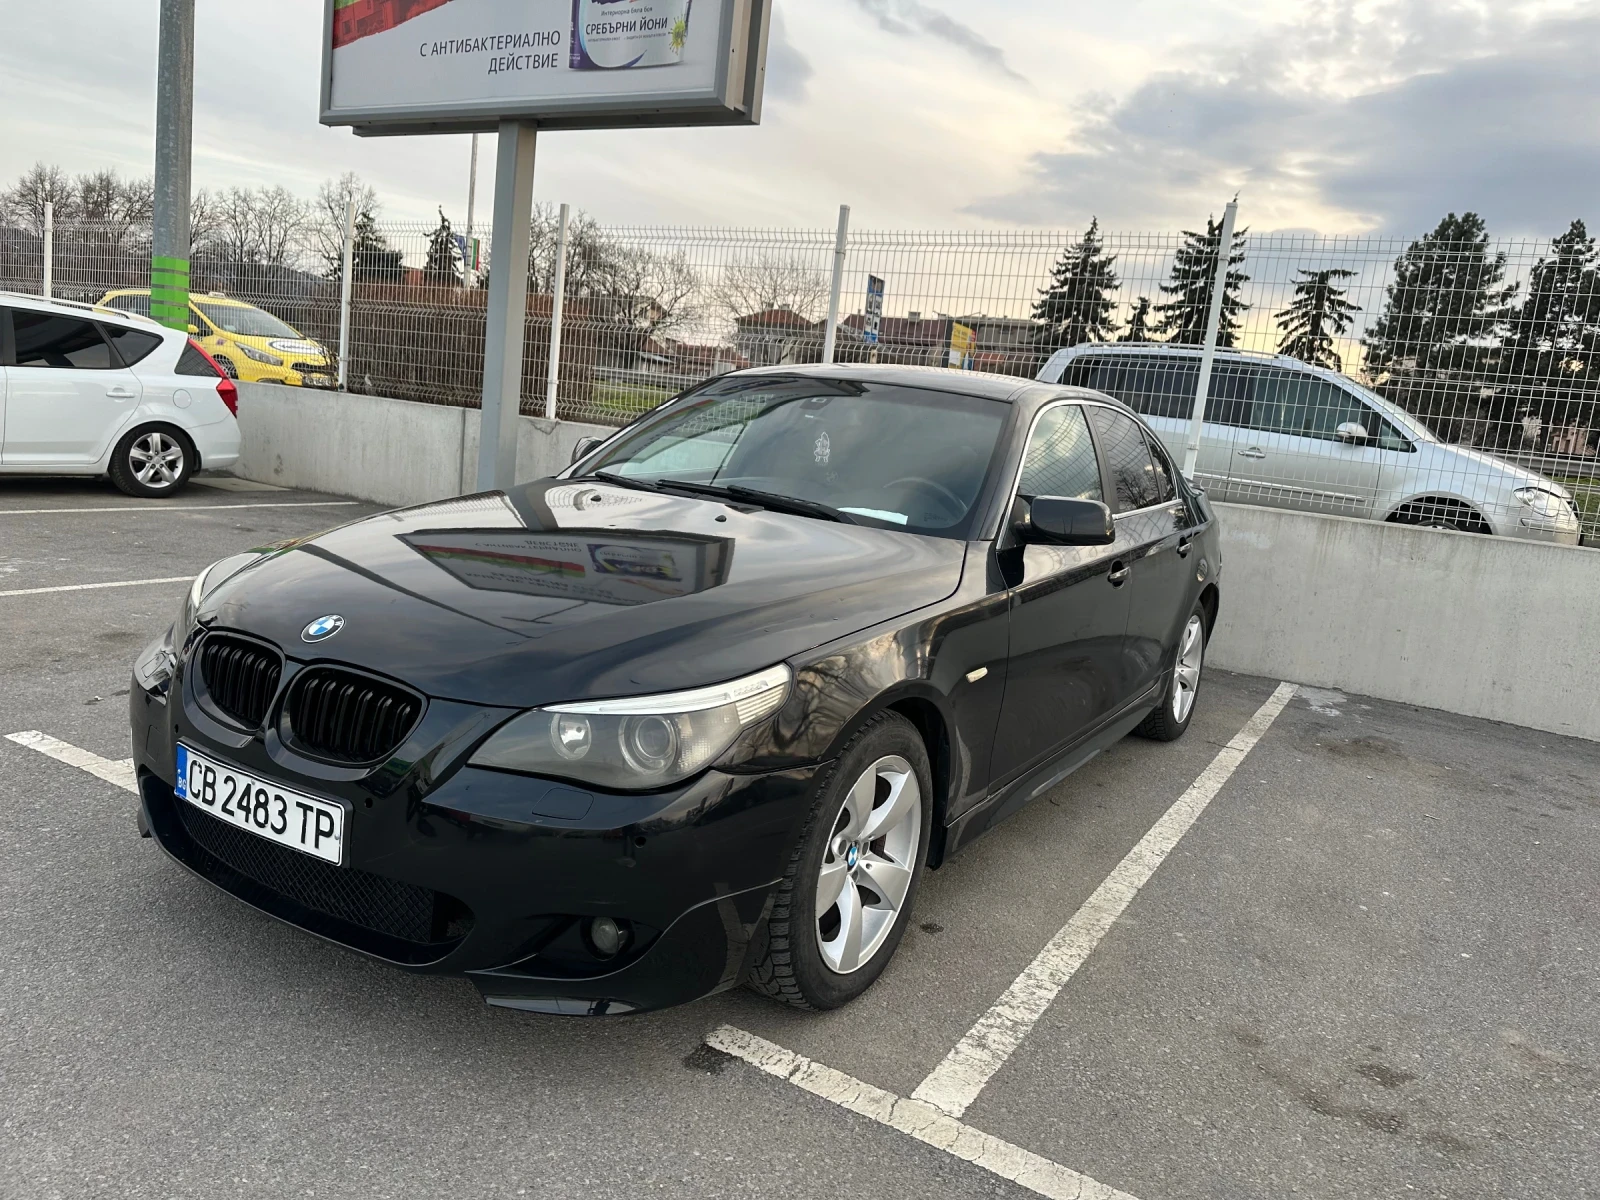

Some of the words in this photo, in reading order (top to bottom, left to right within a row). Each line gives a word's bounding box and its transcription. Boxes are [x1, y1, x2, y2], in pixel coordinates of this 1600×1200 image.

[601, 9, 630, 17] Интериорна
[585, 20, 637, 35] СРЕБЪРНИ
[639, 16, 668, 31] ЙОНИ
[420, 43, 427, 57] С
[431, 30, 561, 56] АНТИБАКТЕРИАЛНО
[488, 52, 559, 75] ДЕЙСТВИЕ
[178, 776, 187, 790] BG
[189, 759, 217, 806] CB
[221, 775, 288, 835] 2483
[295, 800, 335, 849] TP
